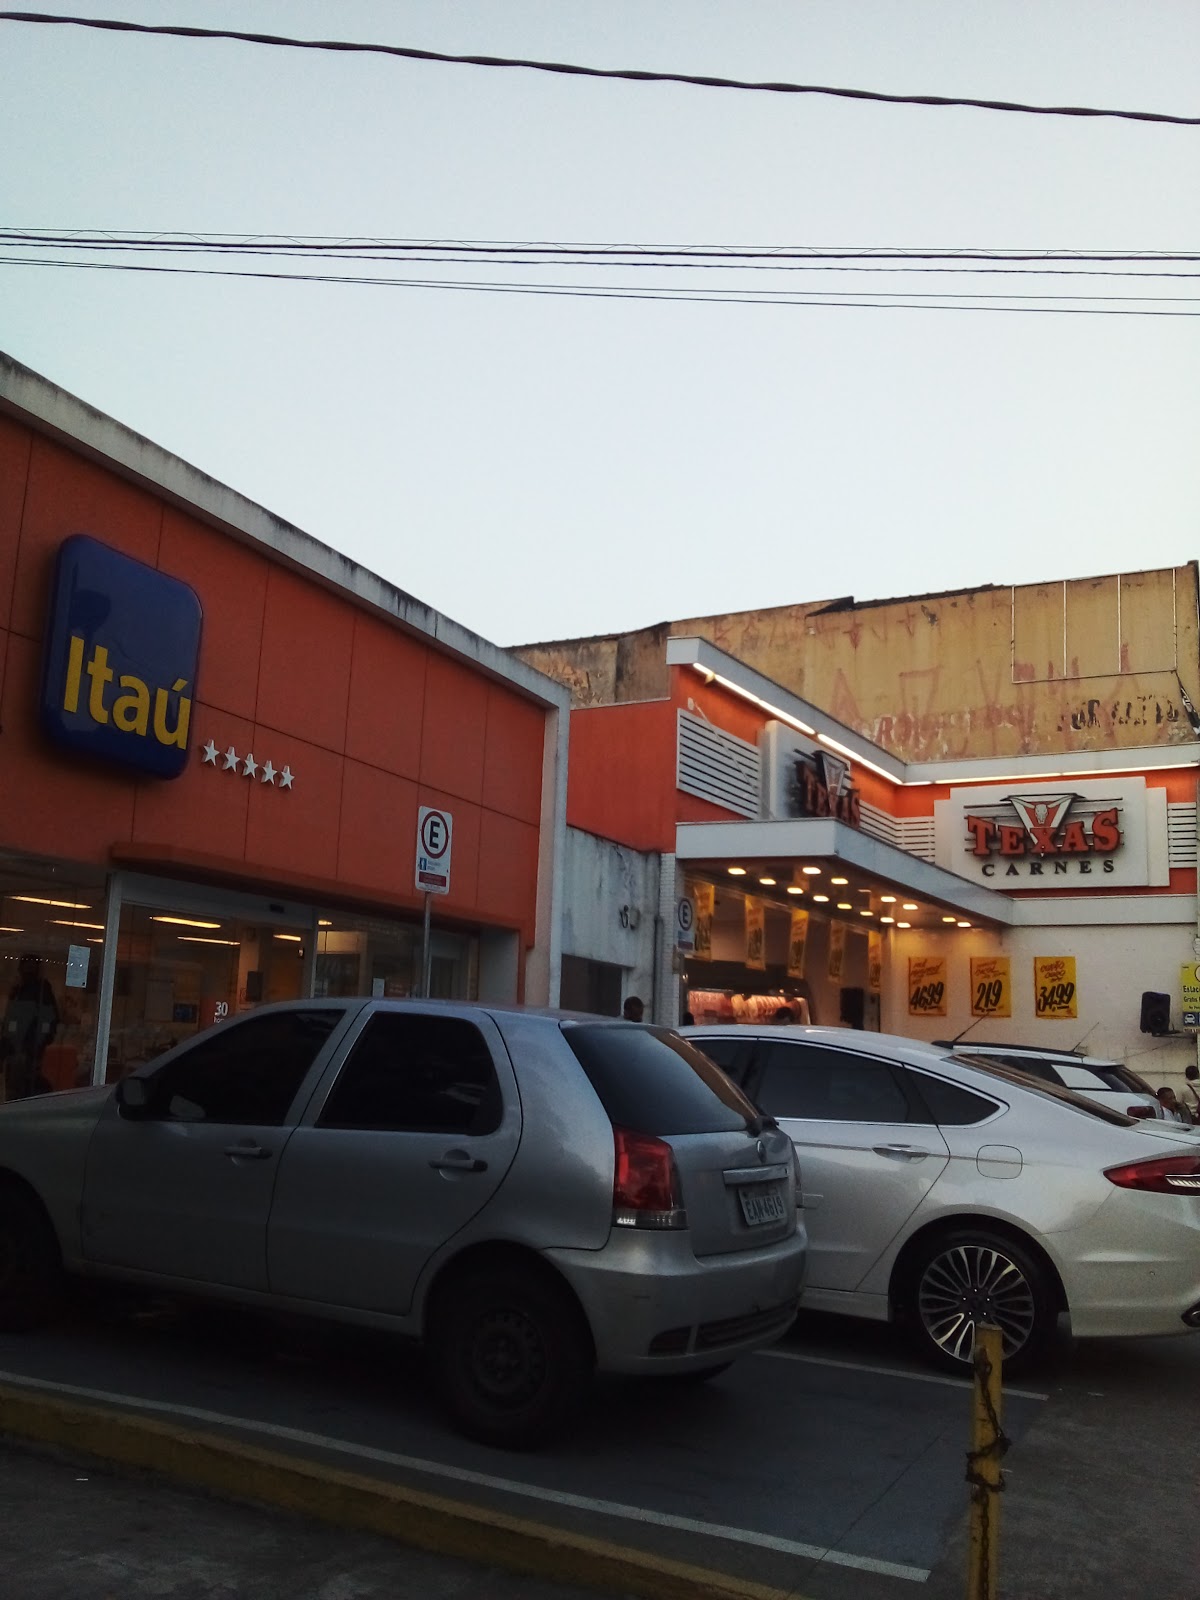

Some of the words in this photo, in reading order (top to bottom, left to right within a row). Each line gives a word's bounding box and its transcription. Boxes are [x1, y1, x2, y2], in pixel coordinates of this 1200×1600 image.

[63, 635, 191, 750] Itaú
[429, 820, 441, 849] E
[967, 807, 1120, 856] TEXAS
[981, 859, 1115, 876] CARNES
[682, 904, 689, 924] E
[214, 1001, 229, 1016] 30
